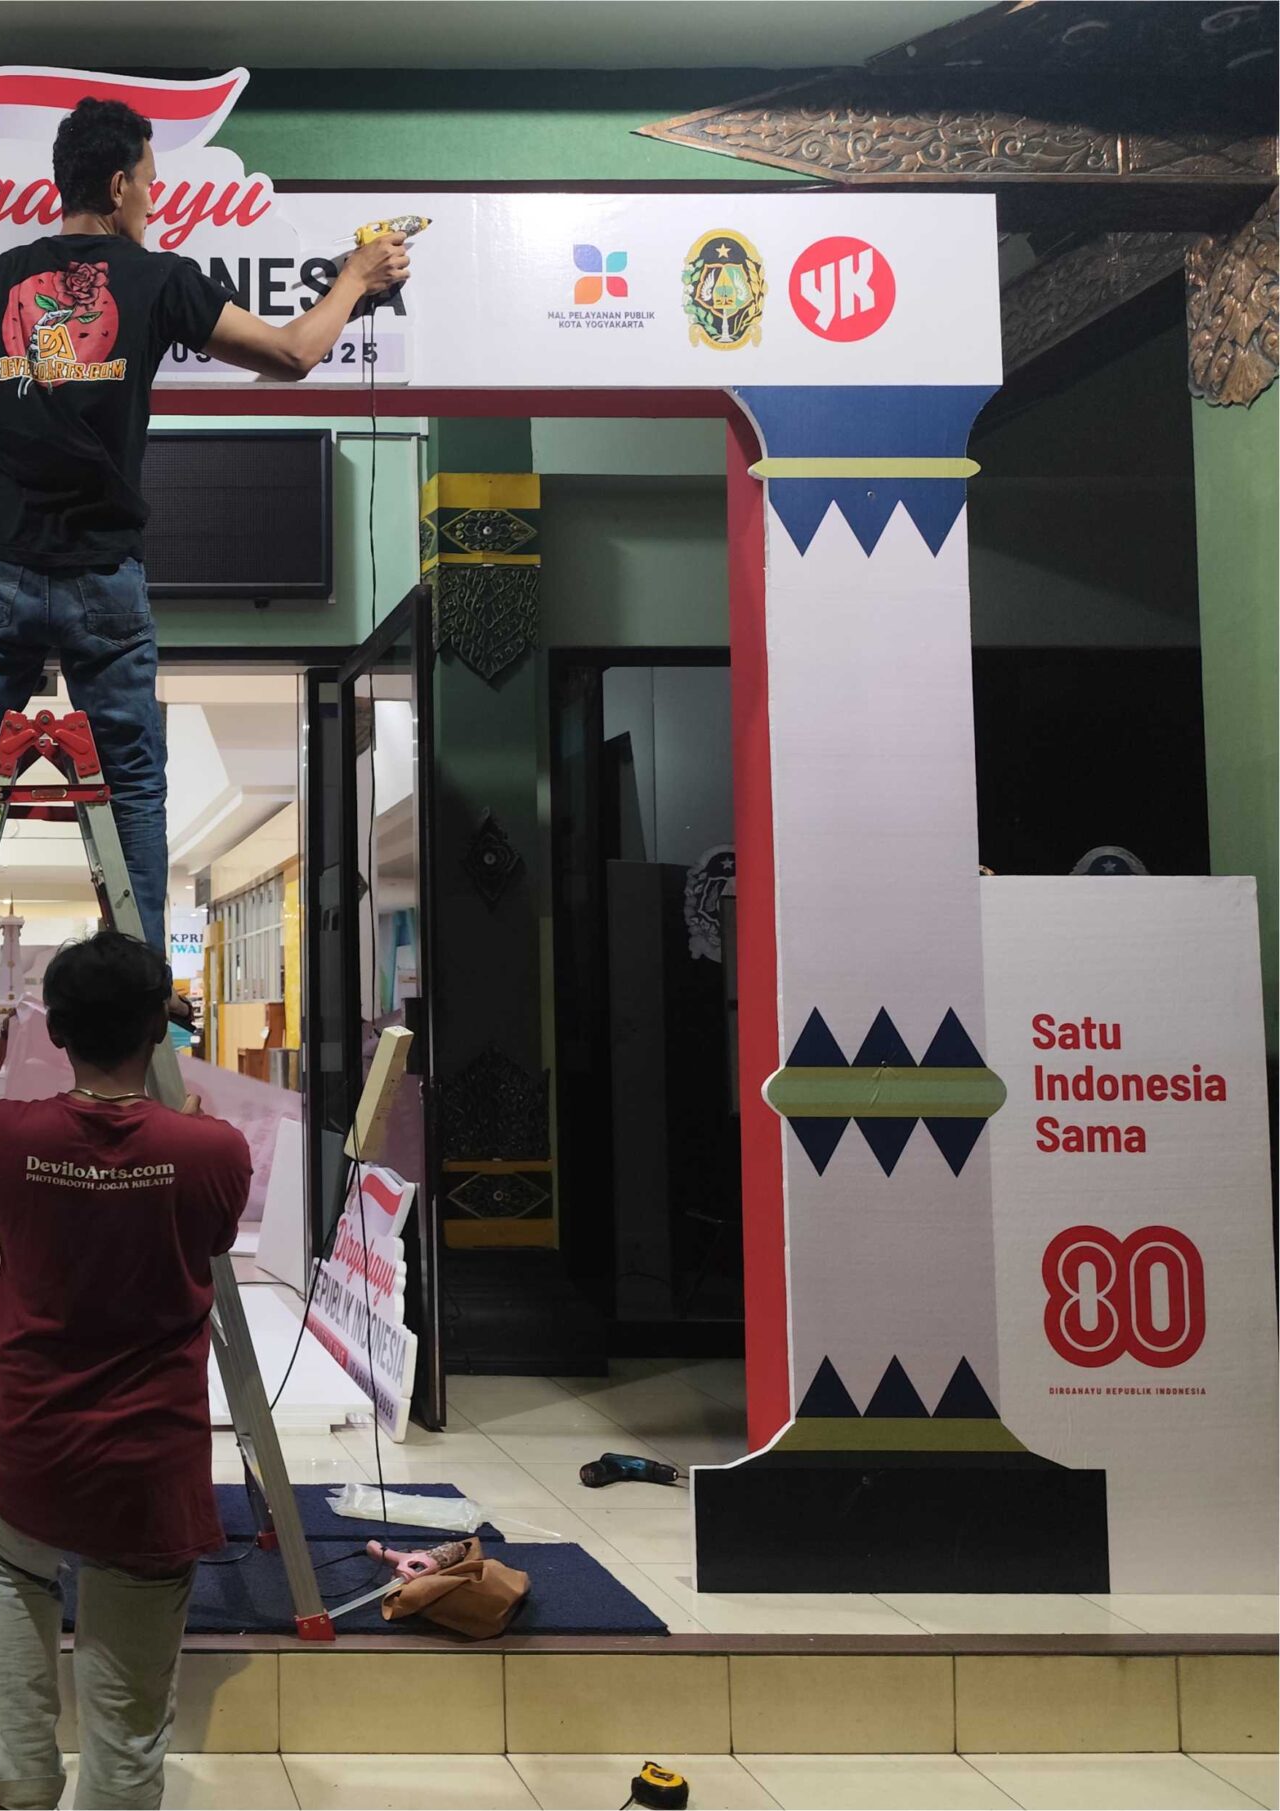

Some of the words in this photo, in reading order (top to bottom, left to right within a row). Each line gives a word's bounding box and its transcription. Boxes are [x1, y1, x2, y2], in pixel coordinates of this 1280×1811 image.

[800, 248, 875, 332] YK
[559, 320, 582, 329] KOTA
[585, 320, 644, 329] YOGYAKARTA
[569, 311, 622, 320] PELAYANAN
[624, 311, 655, 320] PUBLIK
[1032, 1013, 1122, 1050] Satu
[1034, 1064, 1227, 1102] Indonesia
[1036, 1116, 1146, 1153] Sama
[26, 1155, 175, 1180] DeviloArts.com
[26, 1173, 95, 1190] PHOTOBOOTH
[96, 1182, 129, 1190] JOGJA
[132, 1177, 175, 1188] KREATIF
[1041, 1225, 1206, 1368] 80
[350, 1298, 407, 1389] INDONESIA
[1049, 1387, 1102, 1396] DIRGAHAYU
[1106, 1387, 1151, 1396] REPUBLIK
[1155, 1387, 1207, 1396] INDONESIA
